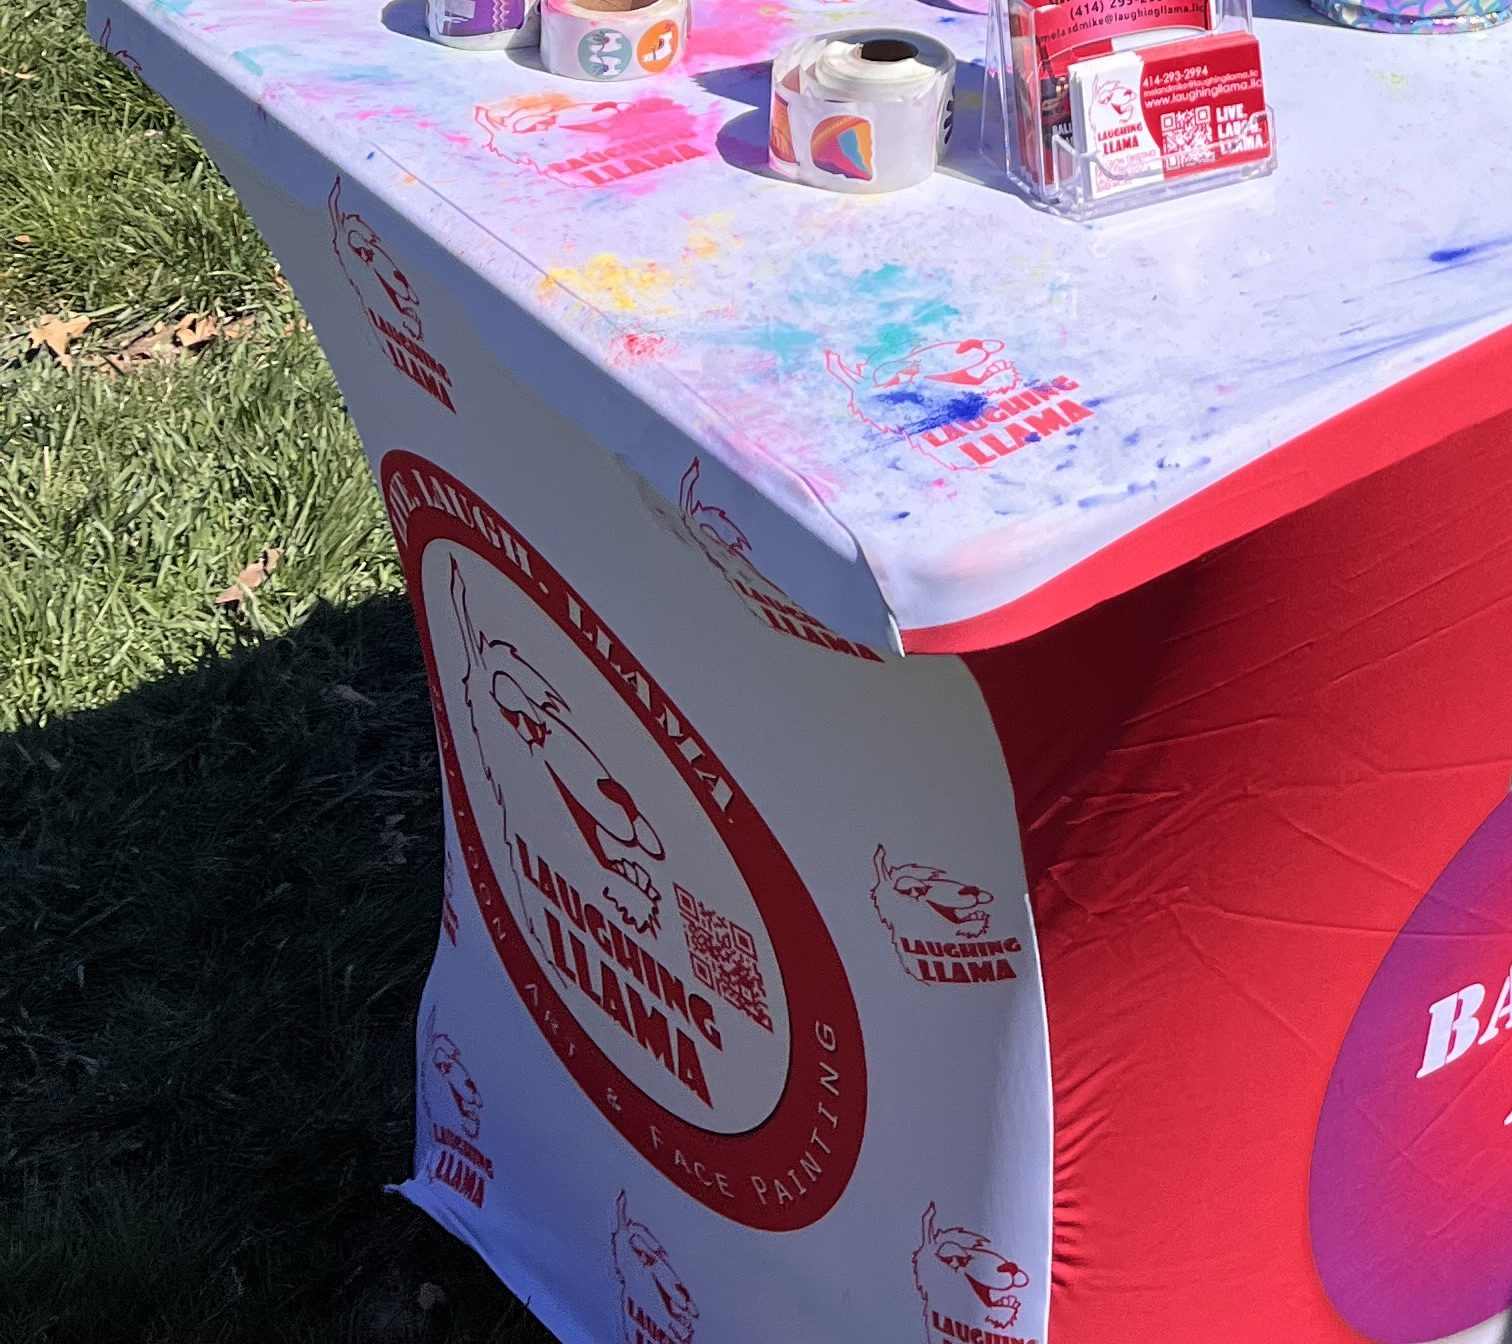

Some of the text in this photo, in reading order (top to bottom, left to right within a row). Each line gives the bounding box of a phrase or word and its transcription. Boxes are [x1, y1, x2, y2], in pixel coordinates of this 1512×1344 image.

[1070, 0, 1105, 21] (414)
[1143, 65, 1209, 88] 414-293-2994
[1098, 122, 1143, 141] LAUGHING
[1103, 135, 1139, 155] LLAMA
[581, 144, 706, 185] LLAMA
[386, 339, 457, 416] LLAMA
[958, 399, 1096, 465] LLAMA
[515, 833, 723, 1053] LAUGHING
[900, 936, 1022, 958] LAUGHING
[917, 958, 1017, 983] LLAMA
[544, 908, 714, 1110] LLAMA
[650, 1124, 735, 1199] FACE
[751, 1019, 841, 1205] PAINTING
[434, 1150, 485, 1209] LLAMA
